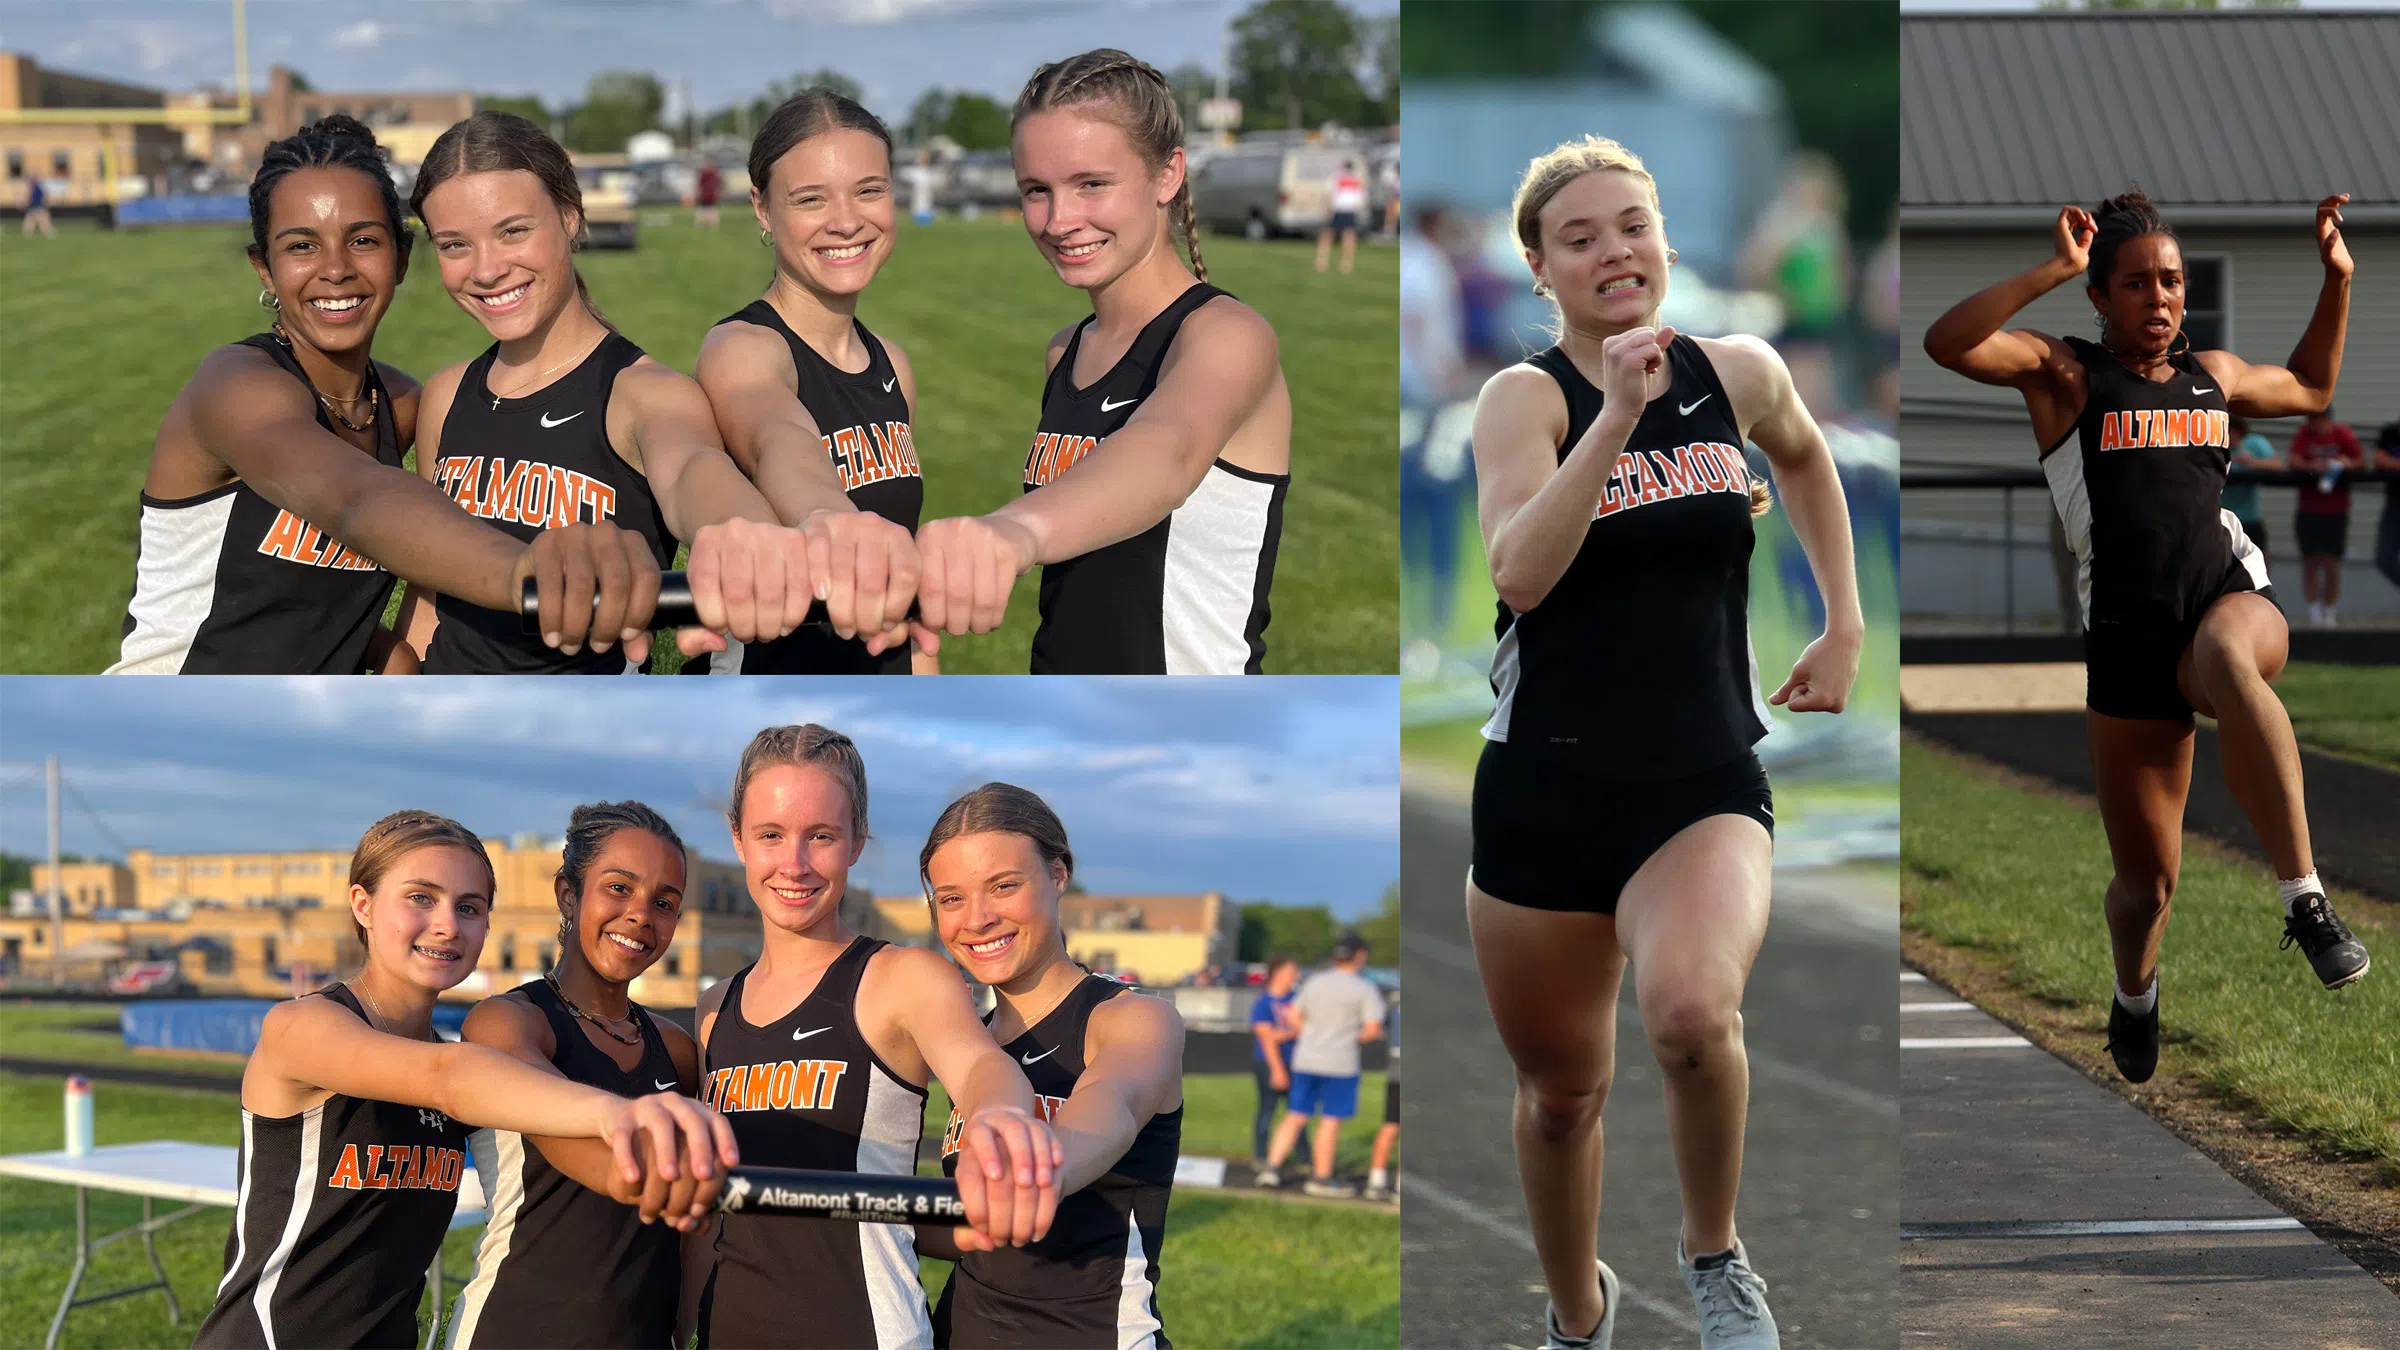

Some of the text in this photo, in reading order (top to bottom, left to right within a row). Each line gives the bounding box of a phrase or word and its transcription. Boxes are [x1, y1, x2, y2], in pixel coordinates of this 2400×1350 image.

[328, 1143, 465, 1194] ALTAMO
[758, 1187, 851, 1211] Altamont
[854, 1192, 909, 1213] Track
[915, 1195, 929, 1214] &
